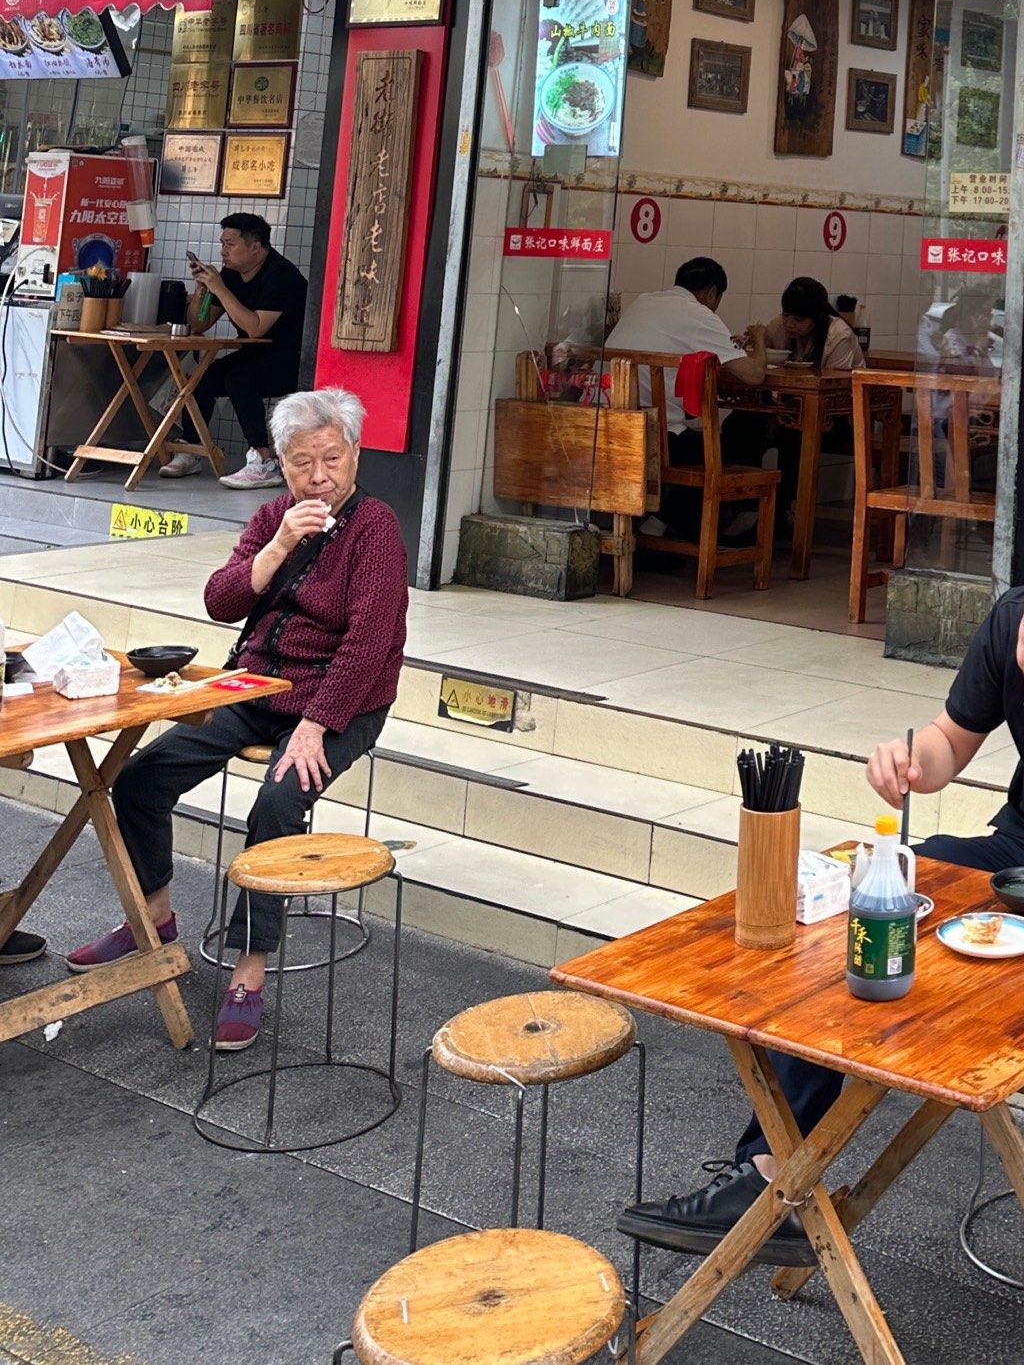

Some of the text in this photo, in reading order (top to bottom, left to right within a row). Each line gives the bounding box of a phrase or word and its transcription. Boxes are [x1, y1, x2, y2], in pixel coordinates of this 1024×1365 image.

[231, 160, 276, 172] 成都名小吃
[970, 174, 1007, 184] 营业时间
[636, 203, 655, 239] 8
[829, 215, 842, 247] 9
[524, 235, 605, 253] 张记口味鲜面庄
[947, 247, 1006, 266] 张记口味
[130, 513, 183, 535] 小心台阶
